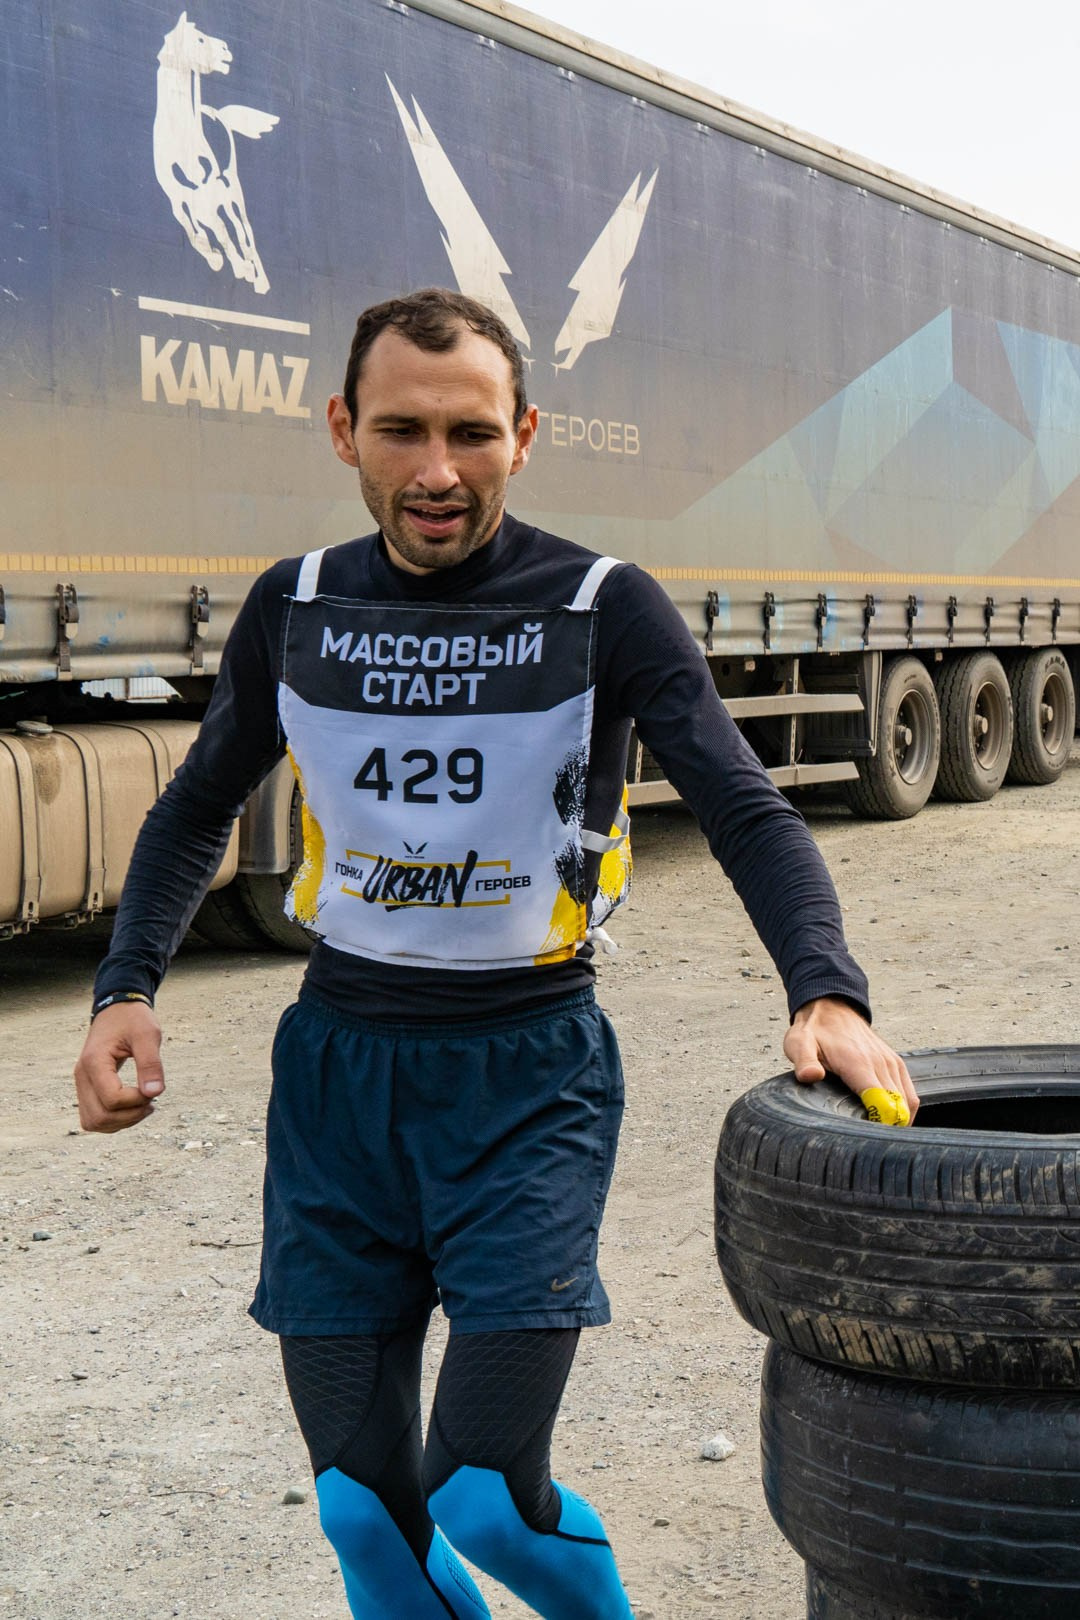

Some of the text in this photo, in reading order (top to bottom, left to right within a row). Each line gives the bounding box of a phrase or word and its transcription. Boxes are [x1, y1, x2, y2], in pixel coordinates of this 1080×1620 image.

[140, 335, 311, 418] KAMAZ
[320, 622, 544, 668] МАССОВЫЙ
[362, 671, 487, 706] СТАРТ
[353, 747, 484, 804] 429
[335, 849, 531, 909] ГОНКА URBAN ГЕРОЕВ
